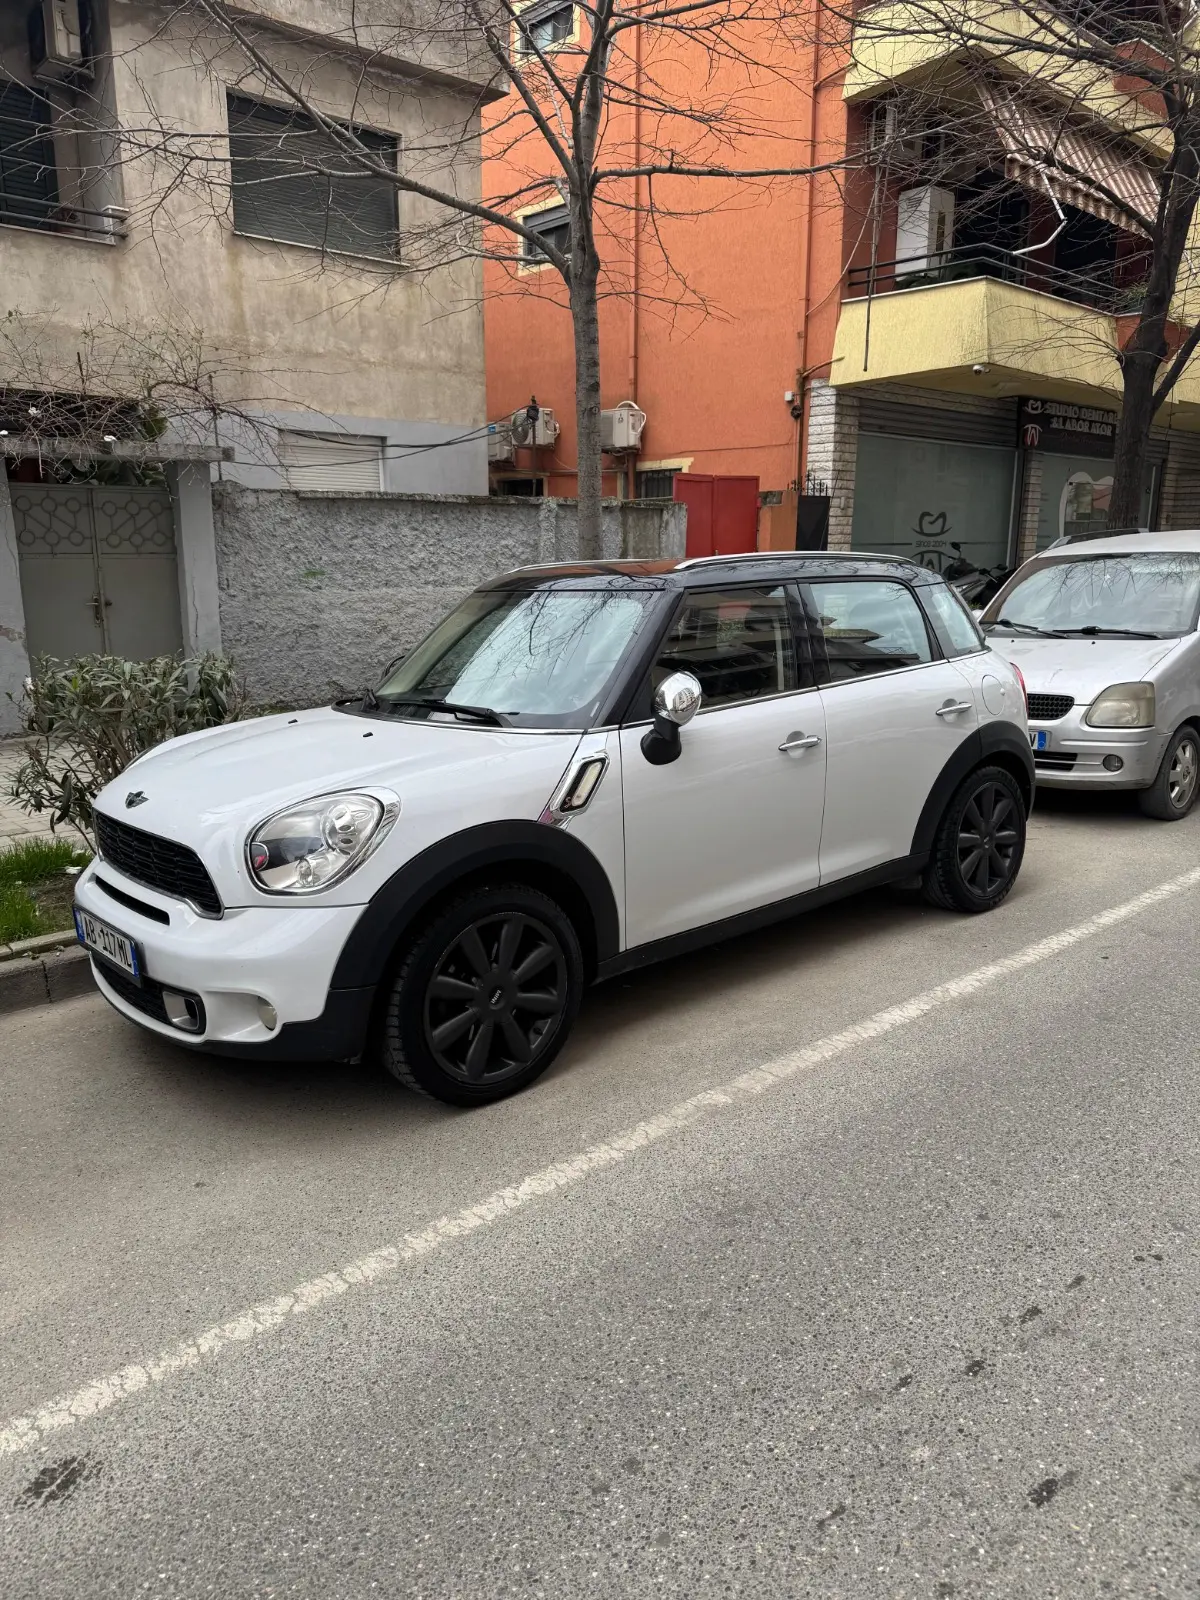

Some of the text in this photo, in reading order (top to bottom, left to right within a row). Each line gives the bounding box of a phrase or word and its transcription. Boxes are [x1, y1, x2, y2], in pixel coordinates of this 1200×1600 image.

[1044, 402, 1079, 418] STUDIO
[84, 915, 97, 945] AB
[100, 926, 116, 958] 117
